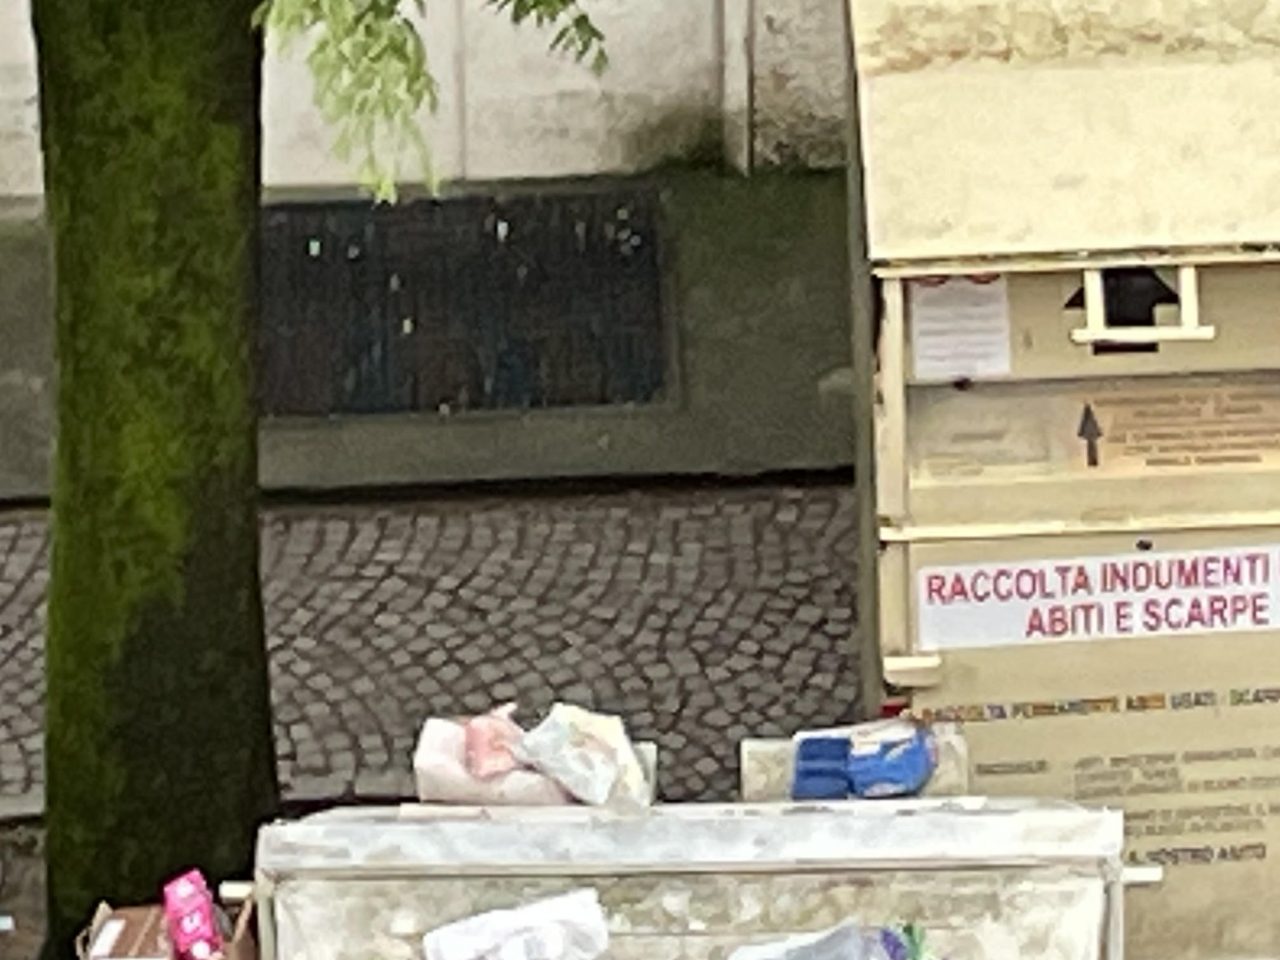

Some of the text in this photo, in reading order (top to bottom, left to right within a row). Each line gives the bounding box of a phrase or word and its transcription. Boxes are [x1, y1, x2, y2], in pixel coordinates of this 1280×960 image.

[926, 565, 1092, 605] RACCOLTA
[1101, 552, 1270, 593] INDUMENTI
[1026, 592, 1270, 637] ABITI E SCARPE
